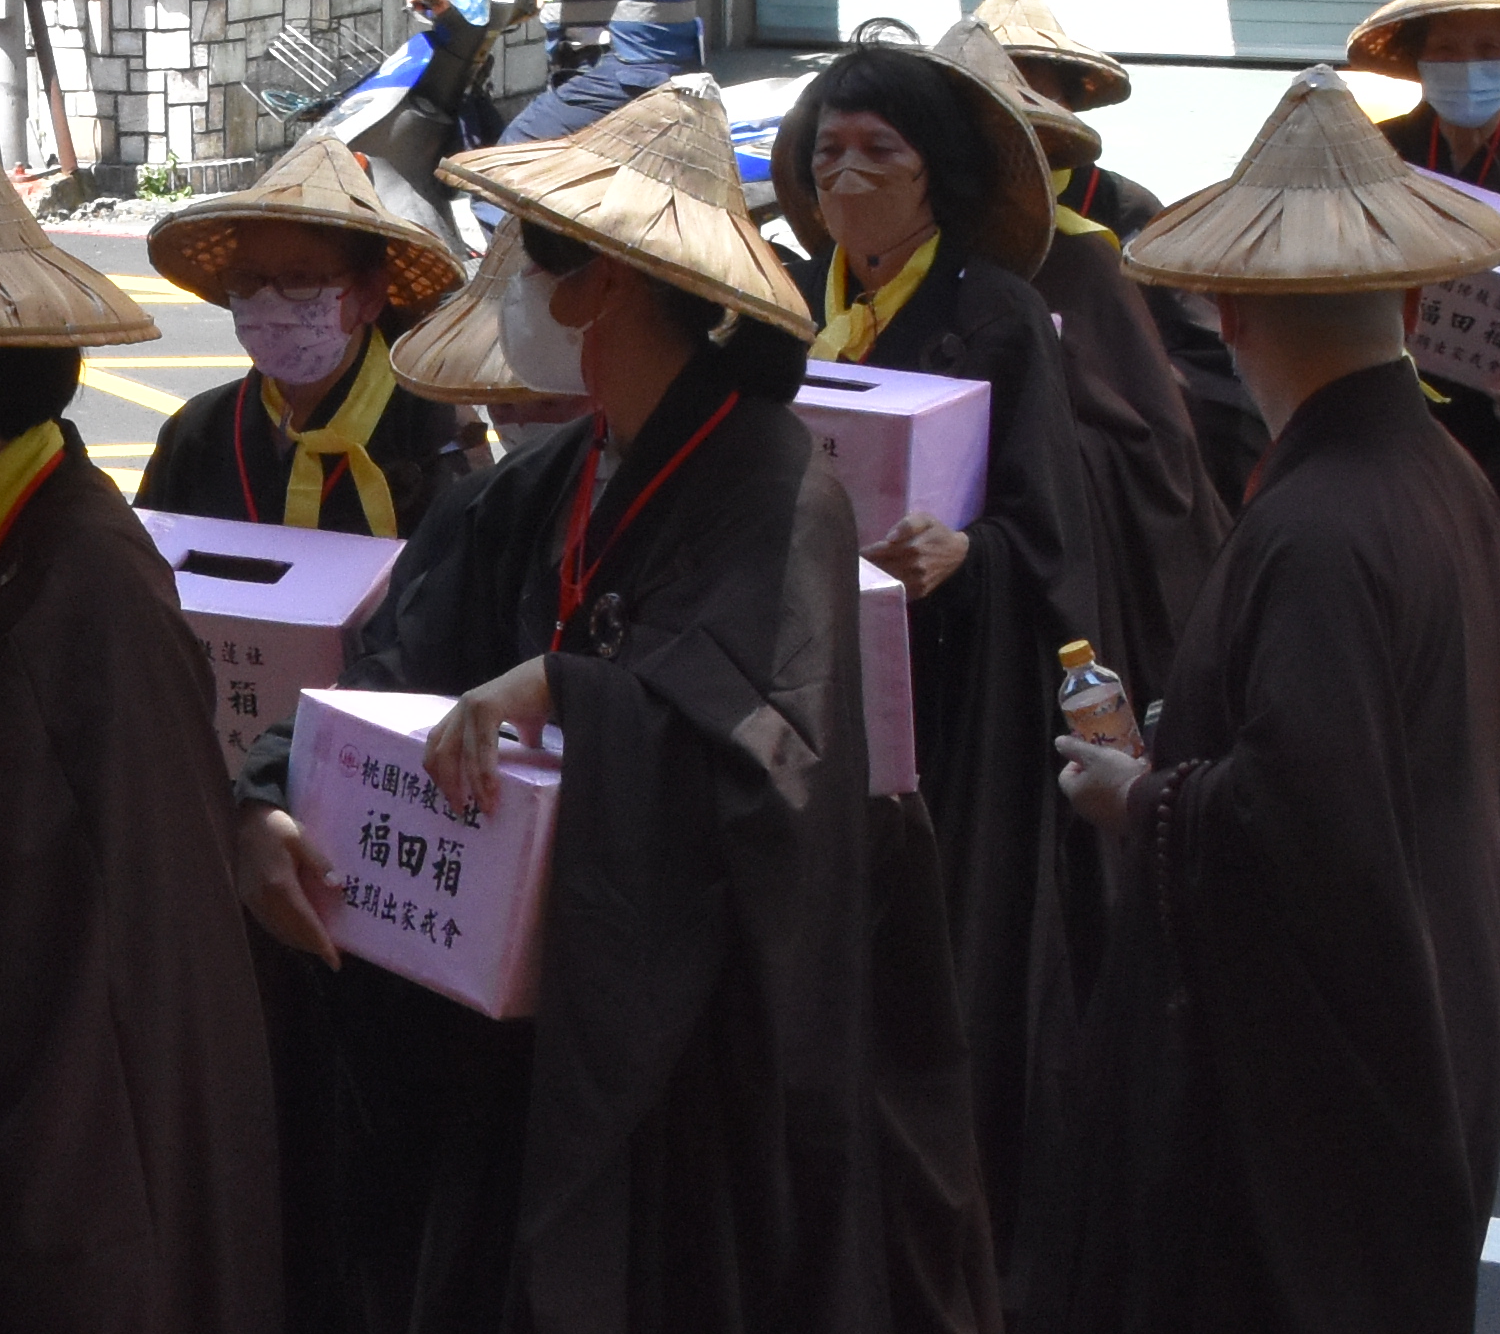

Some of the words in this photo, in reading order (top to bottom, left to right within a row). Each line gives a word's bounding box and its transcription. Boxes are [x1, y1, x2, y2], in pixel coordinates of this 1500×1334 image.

[360, 755, 482, 830] 桃園佛教社
[358, 809, 465, 897] 福田箱
